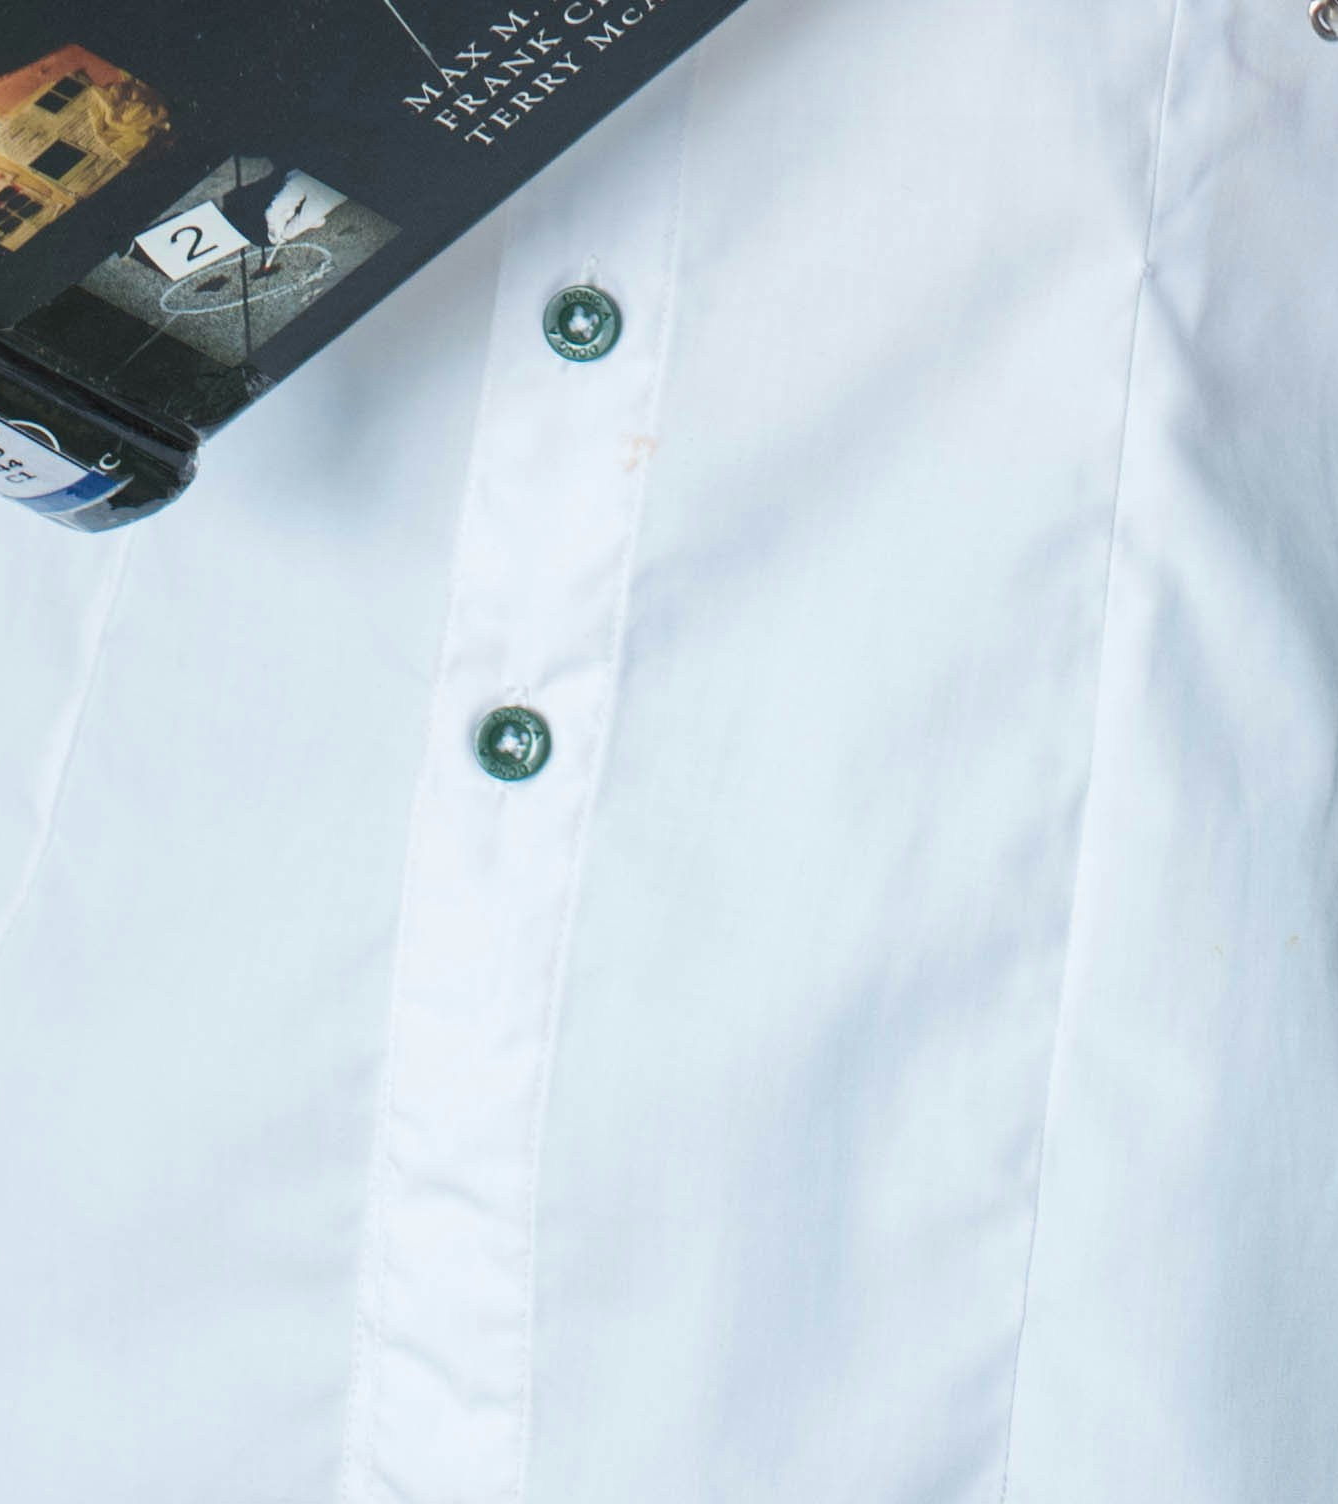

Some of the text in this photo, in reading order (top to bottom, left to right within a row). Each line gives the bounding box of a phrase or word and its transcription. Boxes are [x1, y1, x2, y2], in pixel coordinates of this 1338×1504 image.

[402, 41, 491, 113] MAX
[489, 9, 540, 43] M.
[433, 26, 563, 131] FRANK
[463, 50, 582, 146] TERRY
[169, 224, 221, 263] 2
[6, 469, 38, 487] C1
